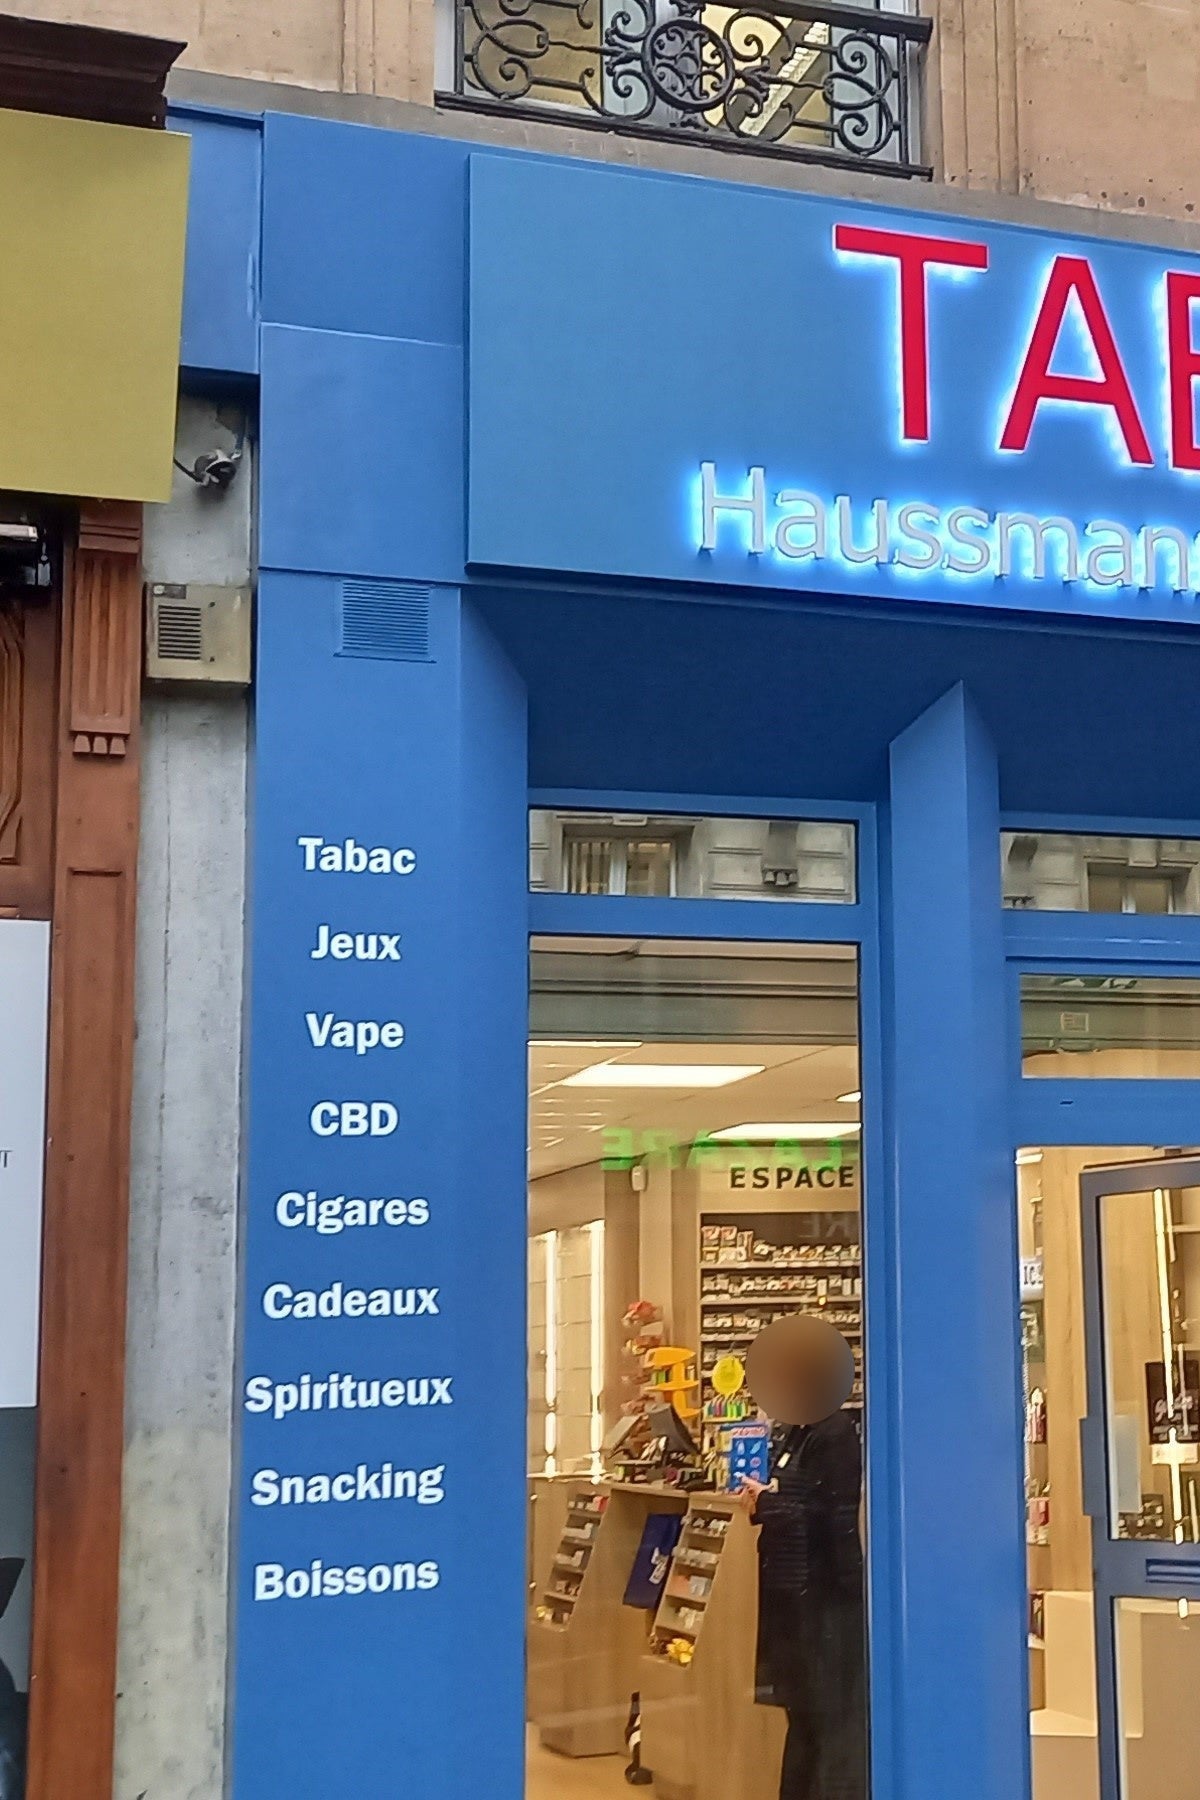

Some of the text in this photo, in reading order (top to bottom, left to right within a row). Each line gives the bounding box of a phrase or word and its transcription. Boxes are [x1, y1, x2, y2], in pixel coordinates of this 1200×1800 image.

[298, 837, 416, 875] Tabac
[311, 925, 401, 960] Jeux
[305, 1013, 404, 1055] Vape
[310, 1101, 398, 1136] CBD
[730, 1165, 856, 1189] ESPACE
[276, 1191, 430, 1234] Cigares
[263, 1282, 440, 1319] Cadeaux
[244, 1373, 453, 1420] Spiritueux
[251, 1463, 445, 1506] Snacking
[254, 1559, 440, 1601] Boissons
